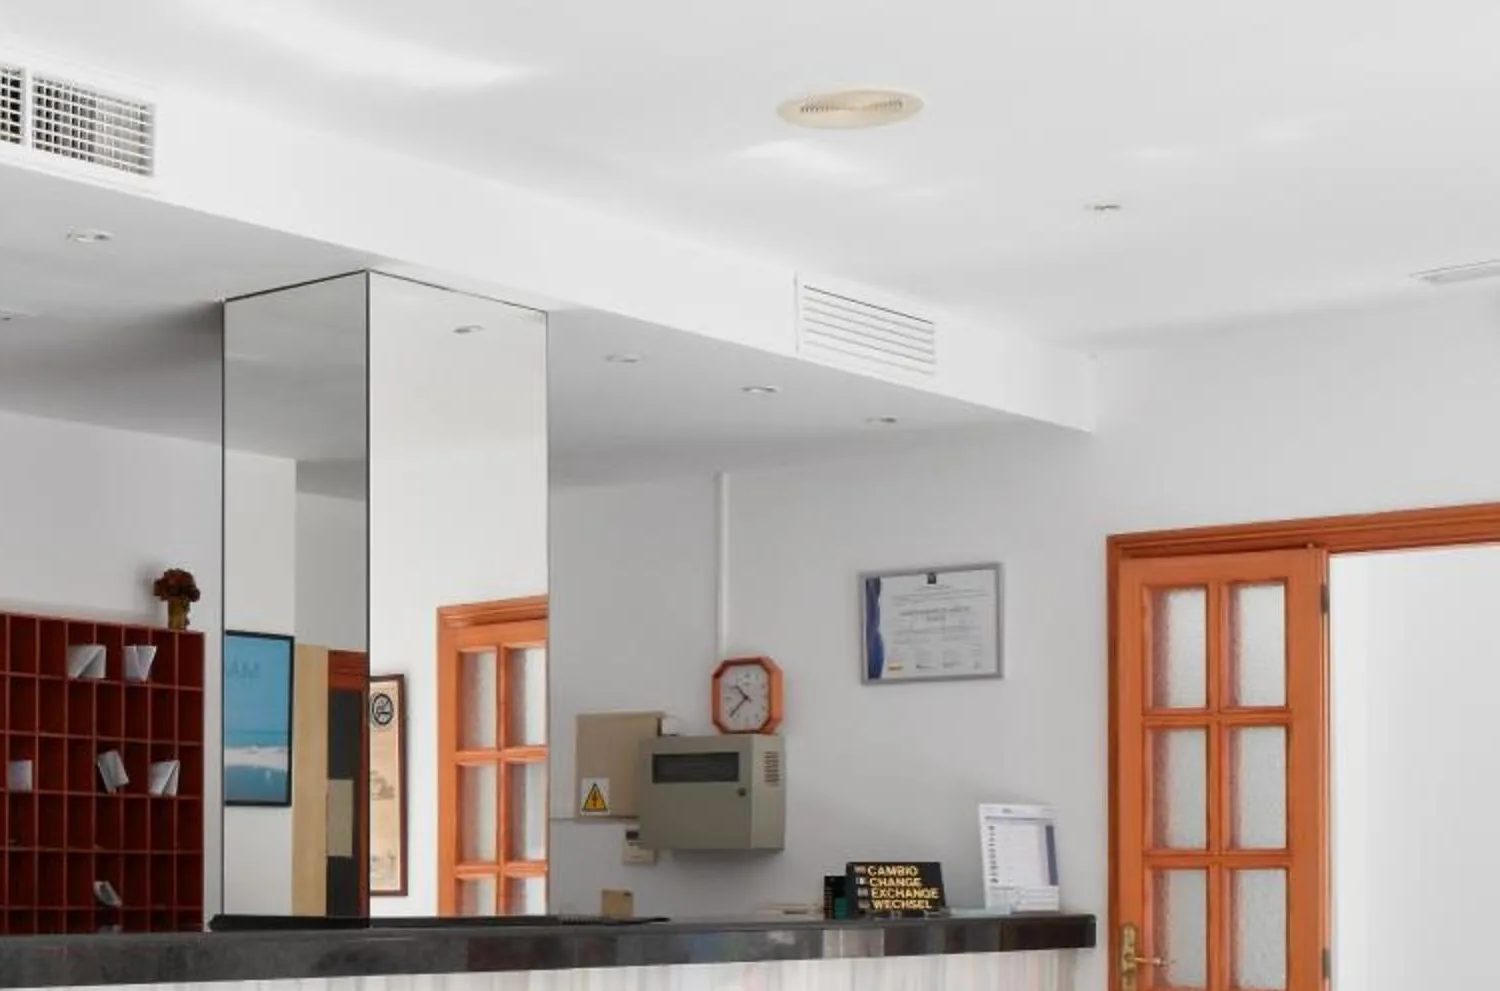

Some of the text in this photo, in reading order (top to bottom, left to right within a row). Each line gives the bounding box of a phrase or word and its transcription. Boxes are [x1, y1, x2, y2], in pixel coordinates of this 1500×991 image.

[867, 865, 919, 876] CAMBIO
[869, 877, 922, 887] CHANGE
[871, 887, 940, 898] EXCHANGE
[872, 899, 932, 909] WECHSEL
